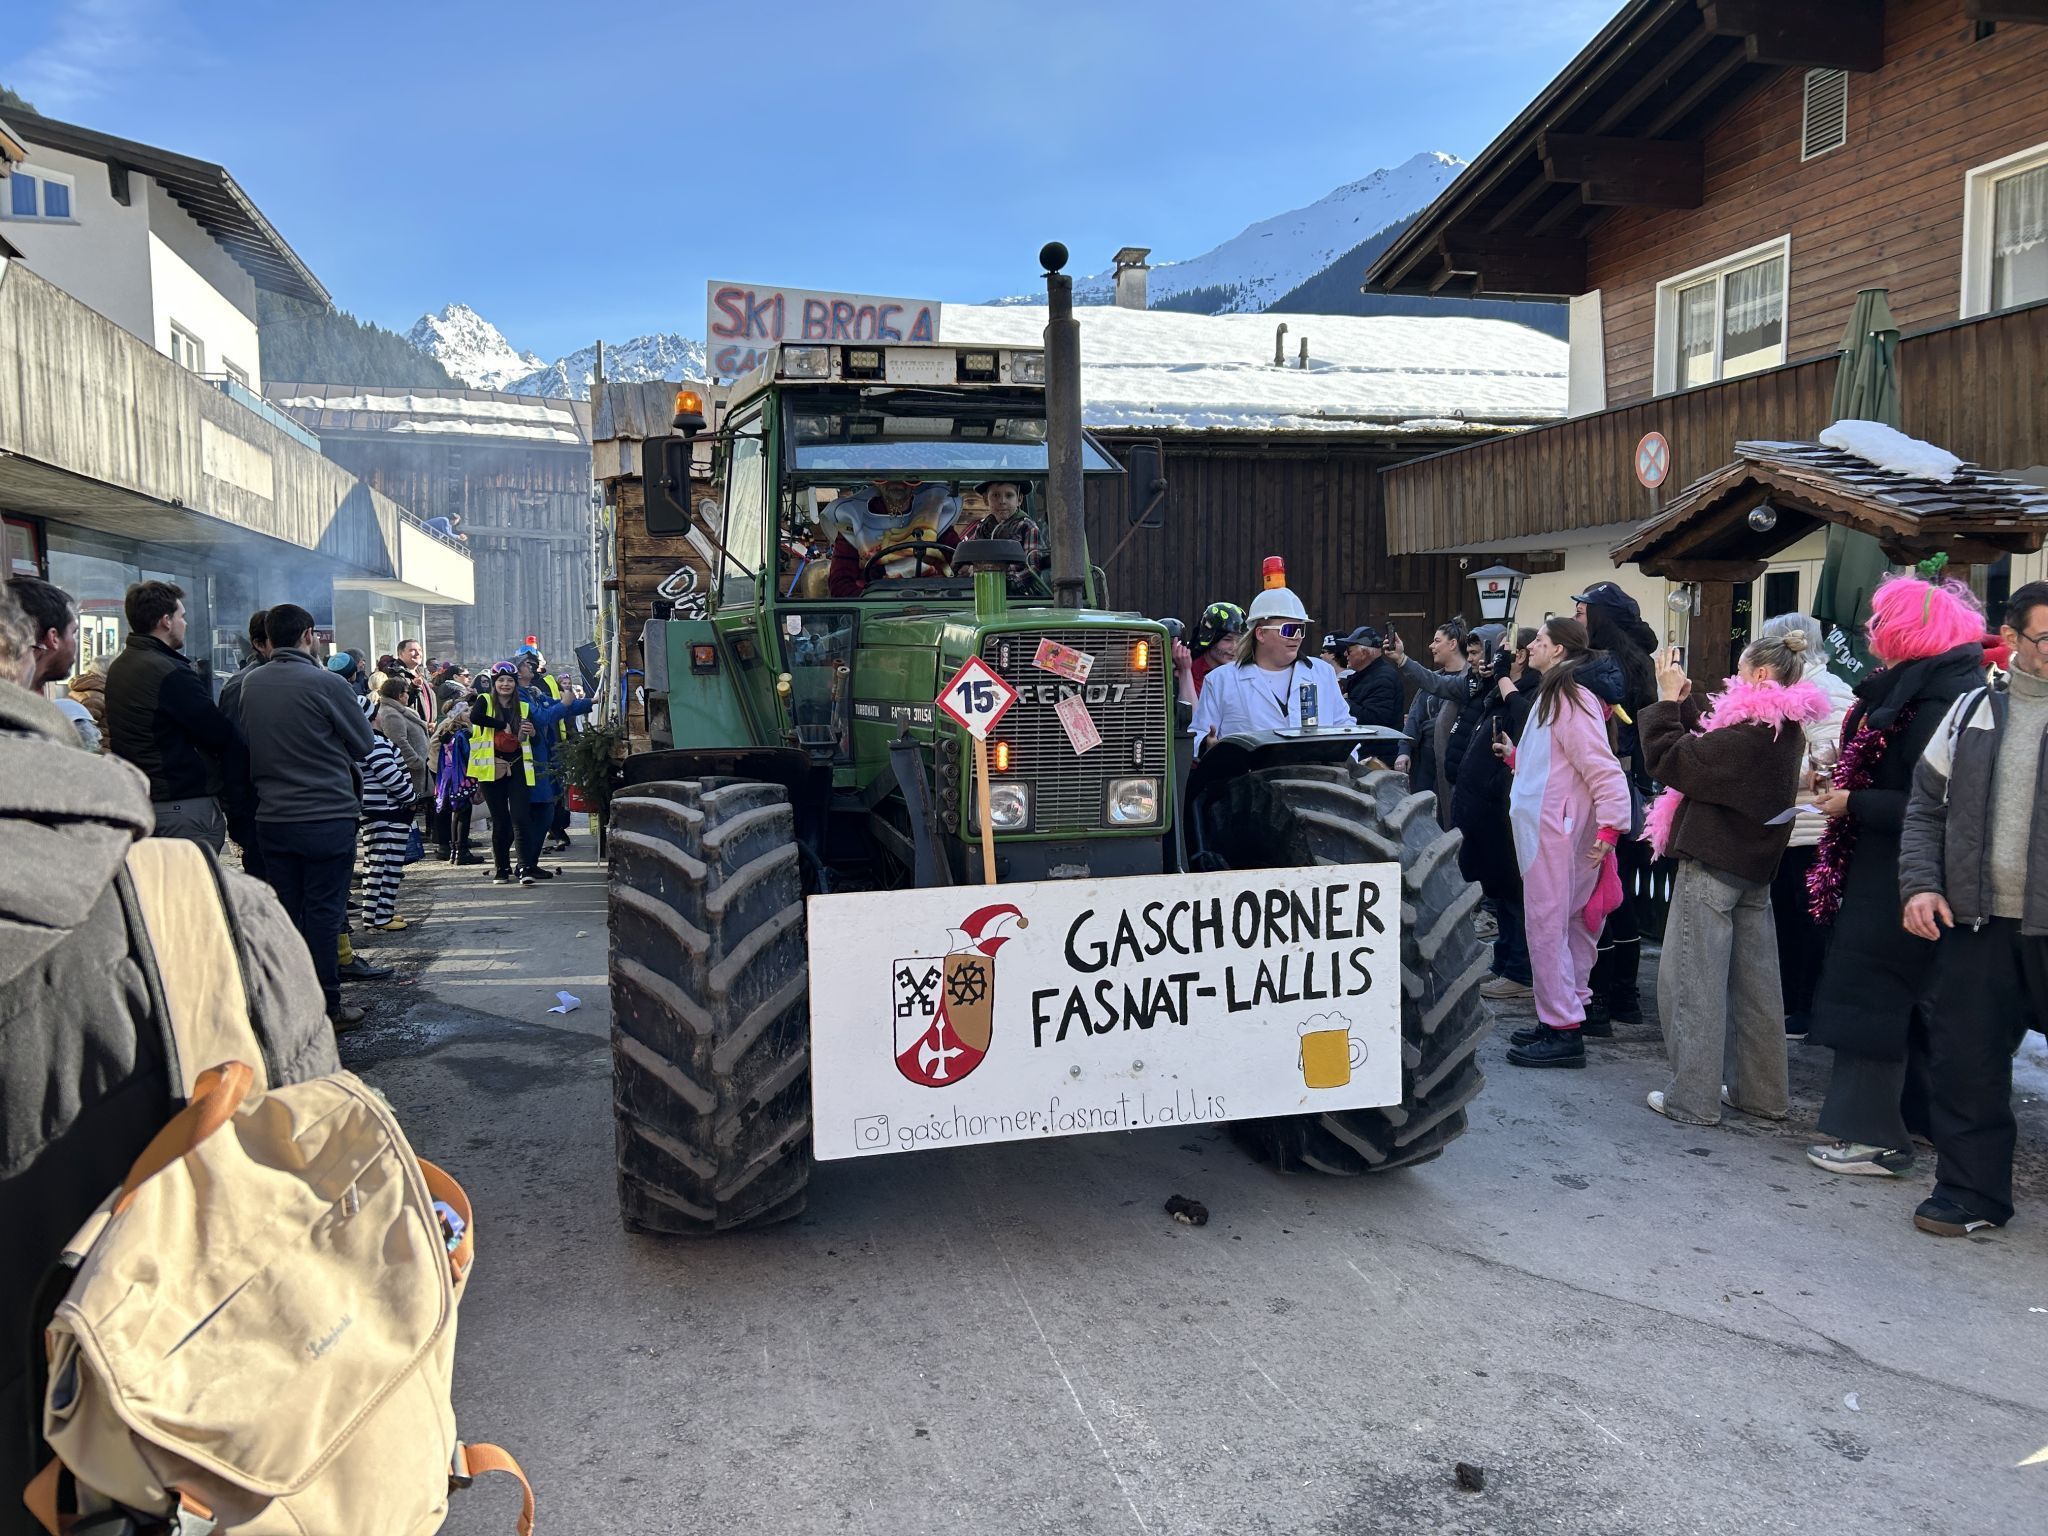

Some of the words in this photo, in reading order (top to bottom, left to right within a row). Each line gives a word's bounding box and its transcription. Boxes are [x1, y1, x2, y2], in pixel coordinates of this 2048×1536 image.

[712, 287, 784, 341] SKI
[957, 680, 994, 714] 15
[1064, 881, 1385, 974] GASCHORNER
[1032, 947, 1375, 1047] FASNAT-LALLIS
